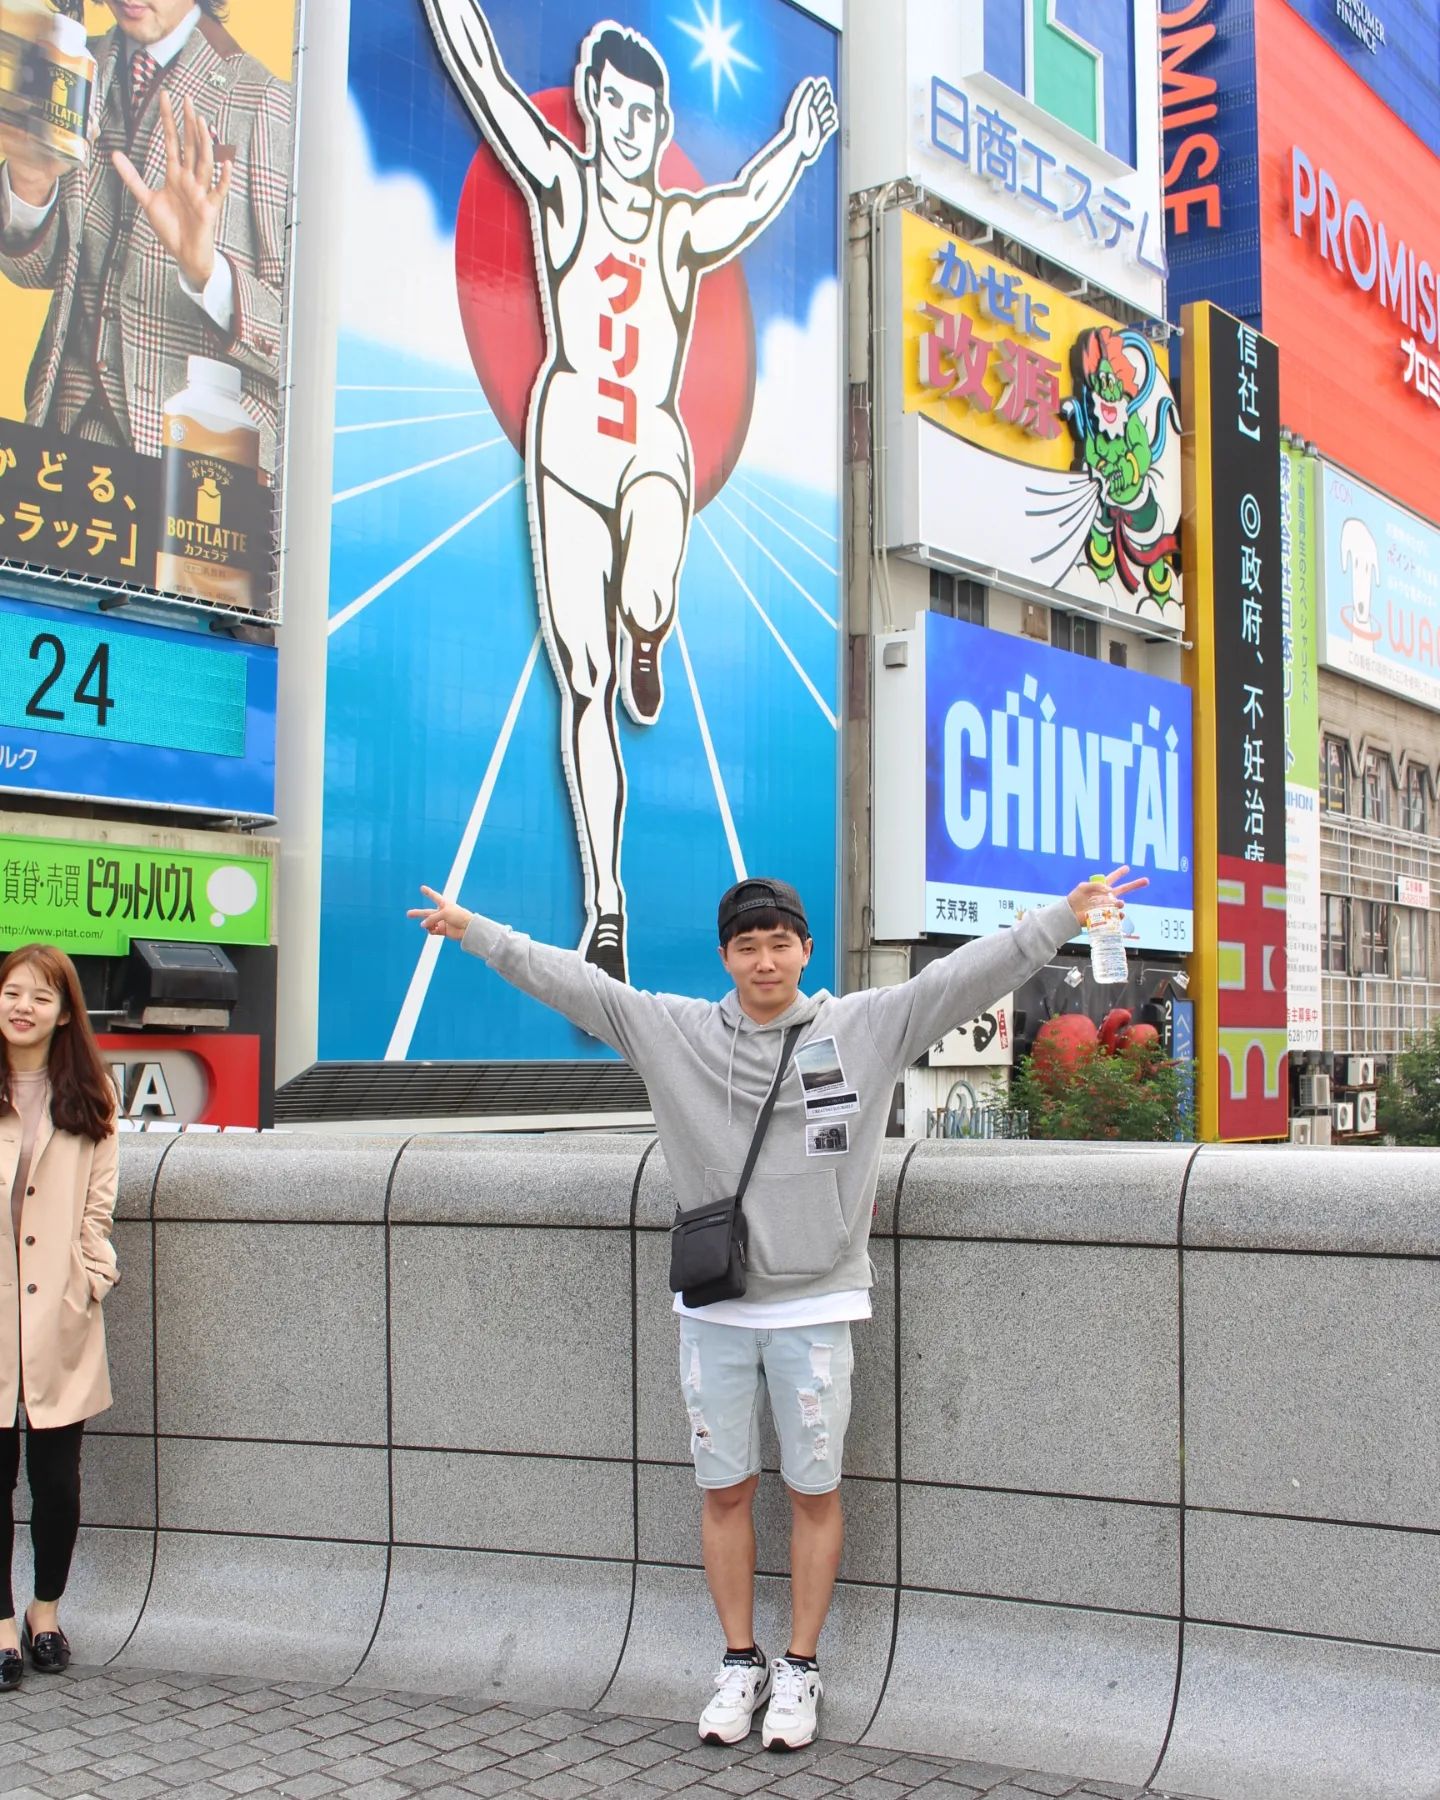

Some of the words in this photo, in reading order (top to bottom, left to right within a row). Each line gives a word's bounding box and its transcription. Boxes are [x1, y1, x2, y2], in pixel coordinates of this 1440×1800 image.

[1336, 0, 1377, 55] FINANCE
[1343, 0, 1386, 48] NSUMER
[930, 75, 1169, 280] 日商エステム
[1290, 144, 1440, 352] PROMIS
[934, 240, 1051, 342] かぜに
[593, 252, 646, 445] グリコ
[918, 303, 1062, 440] 改源
[0, 501, 138, 567] ラッテ」
[167, 515, 248, 553] BOTTLATTE
[184, 542, 229, 563] カフェラテ
[1387, 599, 1440, 670] WA
[25, 632, 115, 727] 24
[86, 856, 196, 923] ピタットハウス
[935, 897, 979, 924] 天気予報
